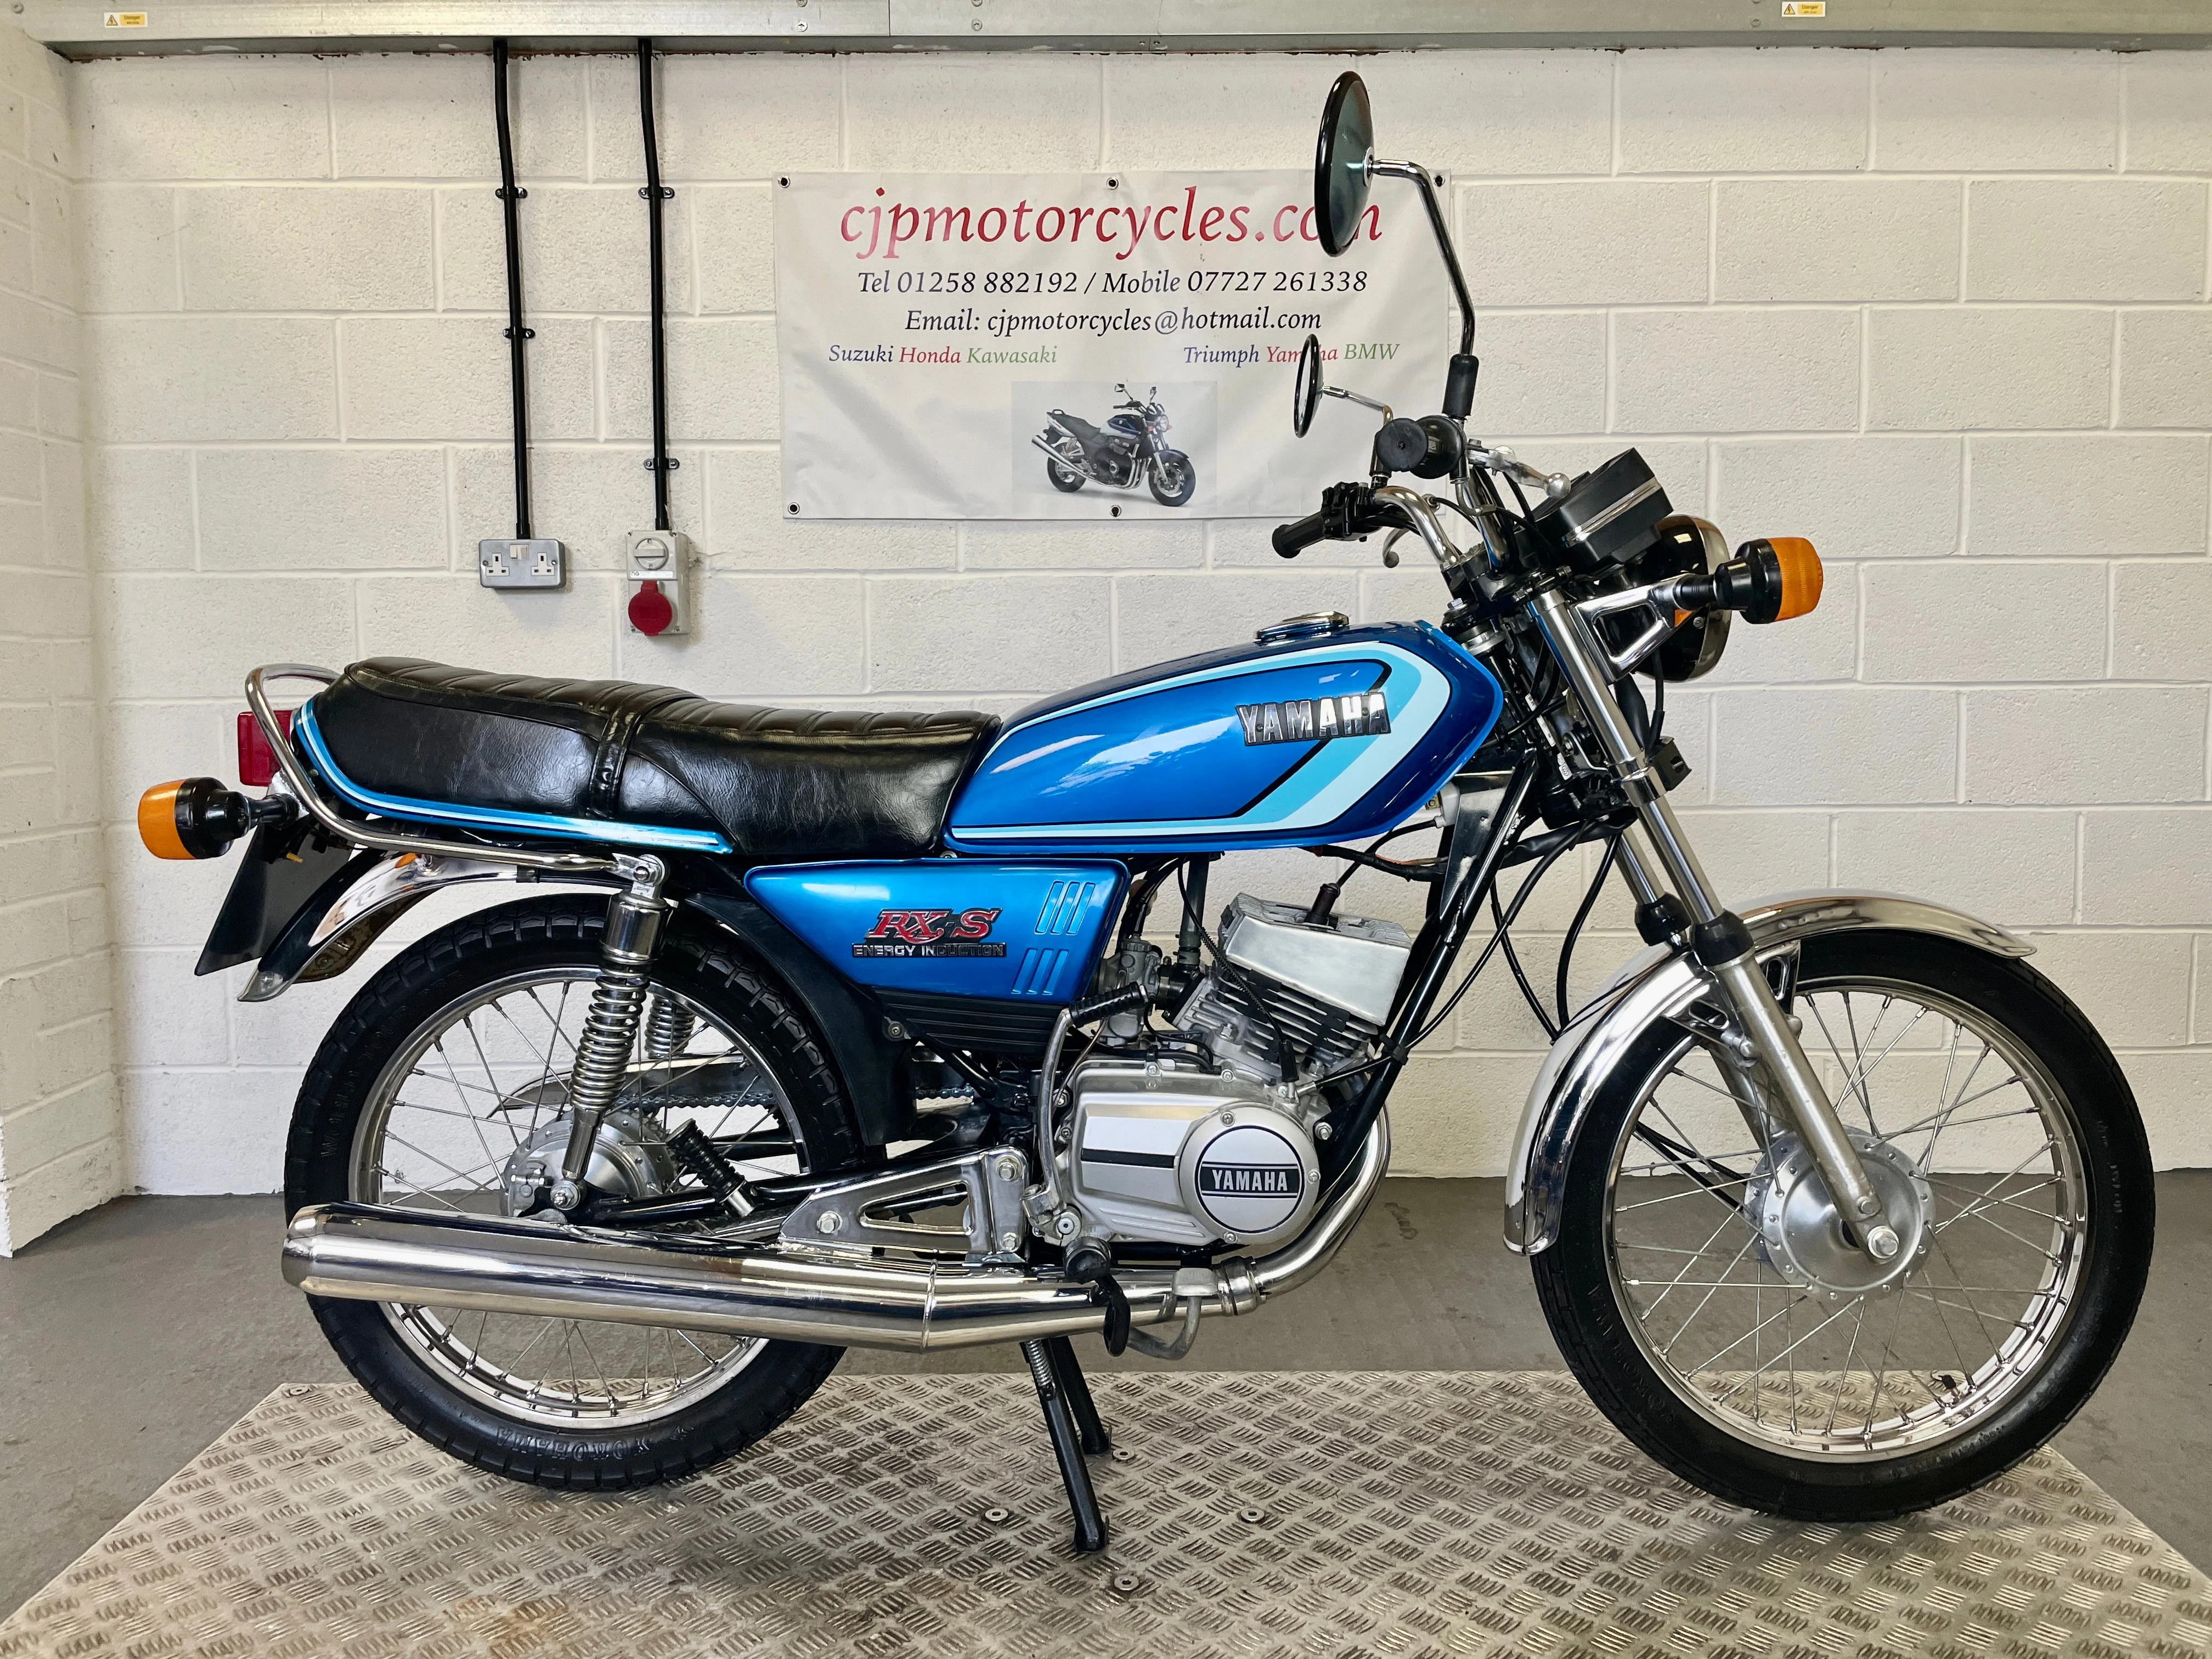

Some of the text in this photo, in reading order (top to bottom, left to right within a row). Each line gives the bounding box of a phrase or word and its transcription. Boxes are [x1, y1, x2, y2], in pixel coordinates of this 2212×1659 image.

[858, 270, 1368, 295] Tel 01258 882192 / Mobile 07727 261338
[905, 306, 1322, 336] Email: cjpmotorcycles@hotmail.com
[829, 345, 1058, 364] Suzuki Honda Kawasaki
[1184, 343, 1401, 368] Triumph Yamha BMW
[1238, 693, 1390, 744] YAMAHA
[854, 944, 1003, 957] ENERGY INDUCTION
[1212, 1169, 1288, 1191] YAMAHA
